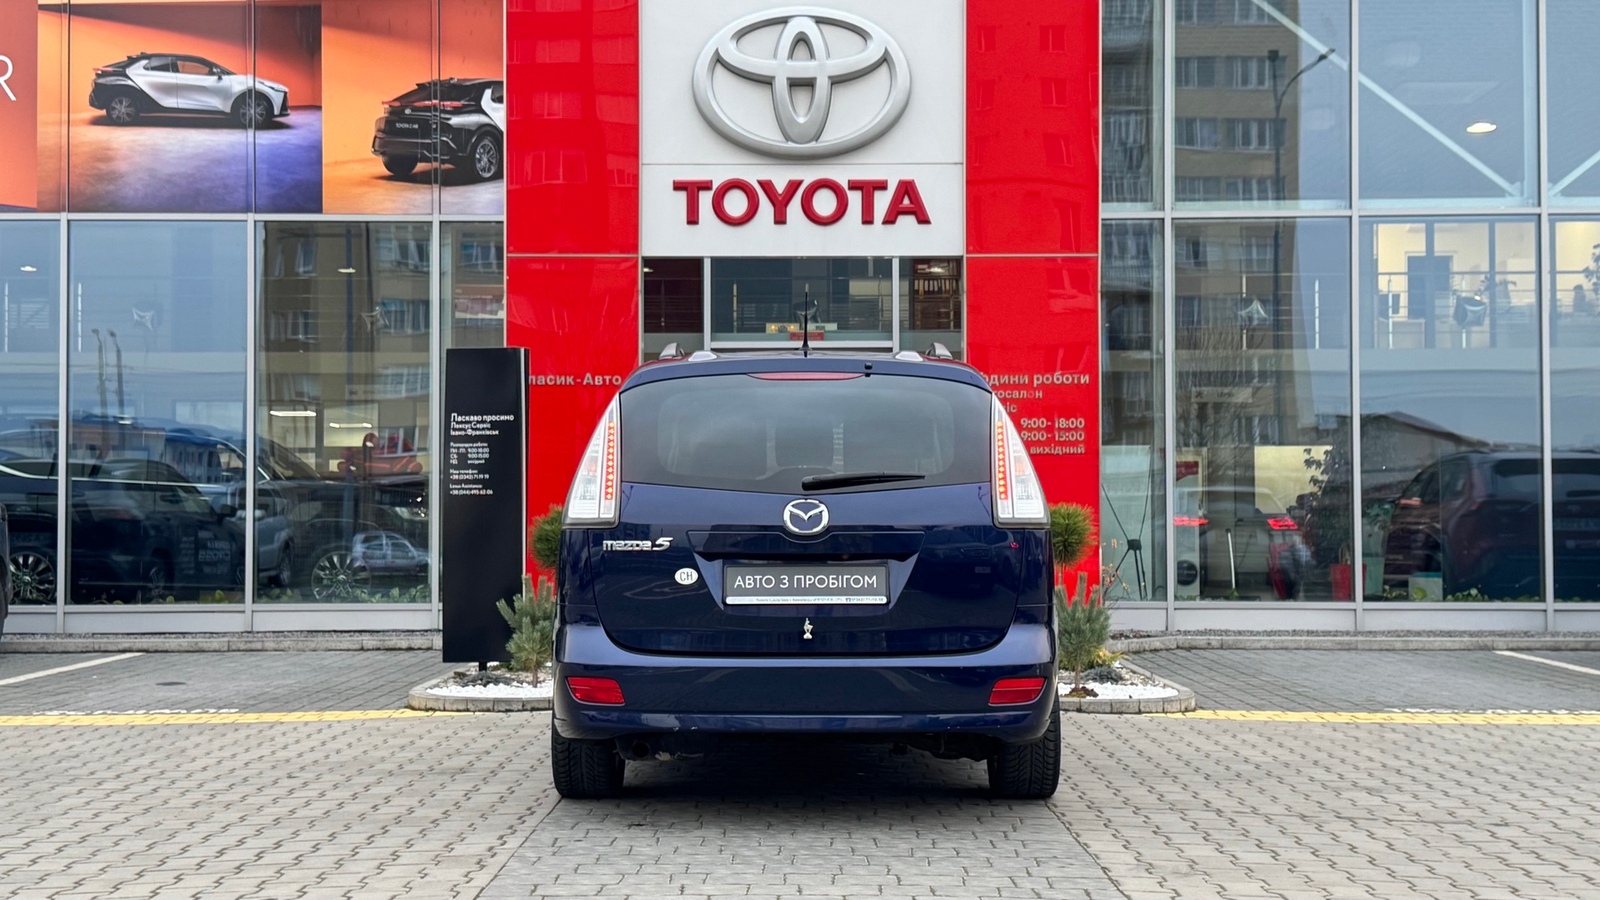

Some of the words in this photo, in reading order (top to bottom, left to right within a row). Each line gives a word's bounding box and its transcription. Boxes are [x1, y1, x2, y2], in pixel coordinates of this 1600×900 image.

[673, 178, 932, 226] TOYOTA
[979, 372, 1029, 386] одини
[1033, 371, 1090, 387] роботи
[995, 390, 1043, 399] осалон
[451, 413, 482, 421] Ласкаво
[1030, 443, 1085, 455] вихідний
[602, 540, 652, 551] mazda
[652, 537, 674, 551] 5
[679, 571, 693, 582] CH
[734, 575, 776, 588] АВТО
[779, 575, 789, 588] З
[794, 575, 877, 588] ПРОБІГОМ
